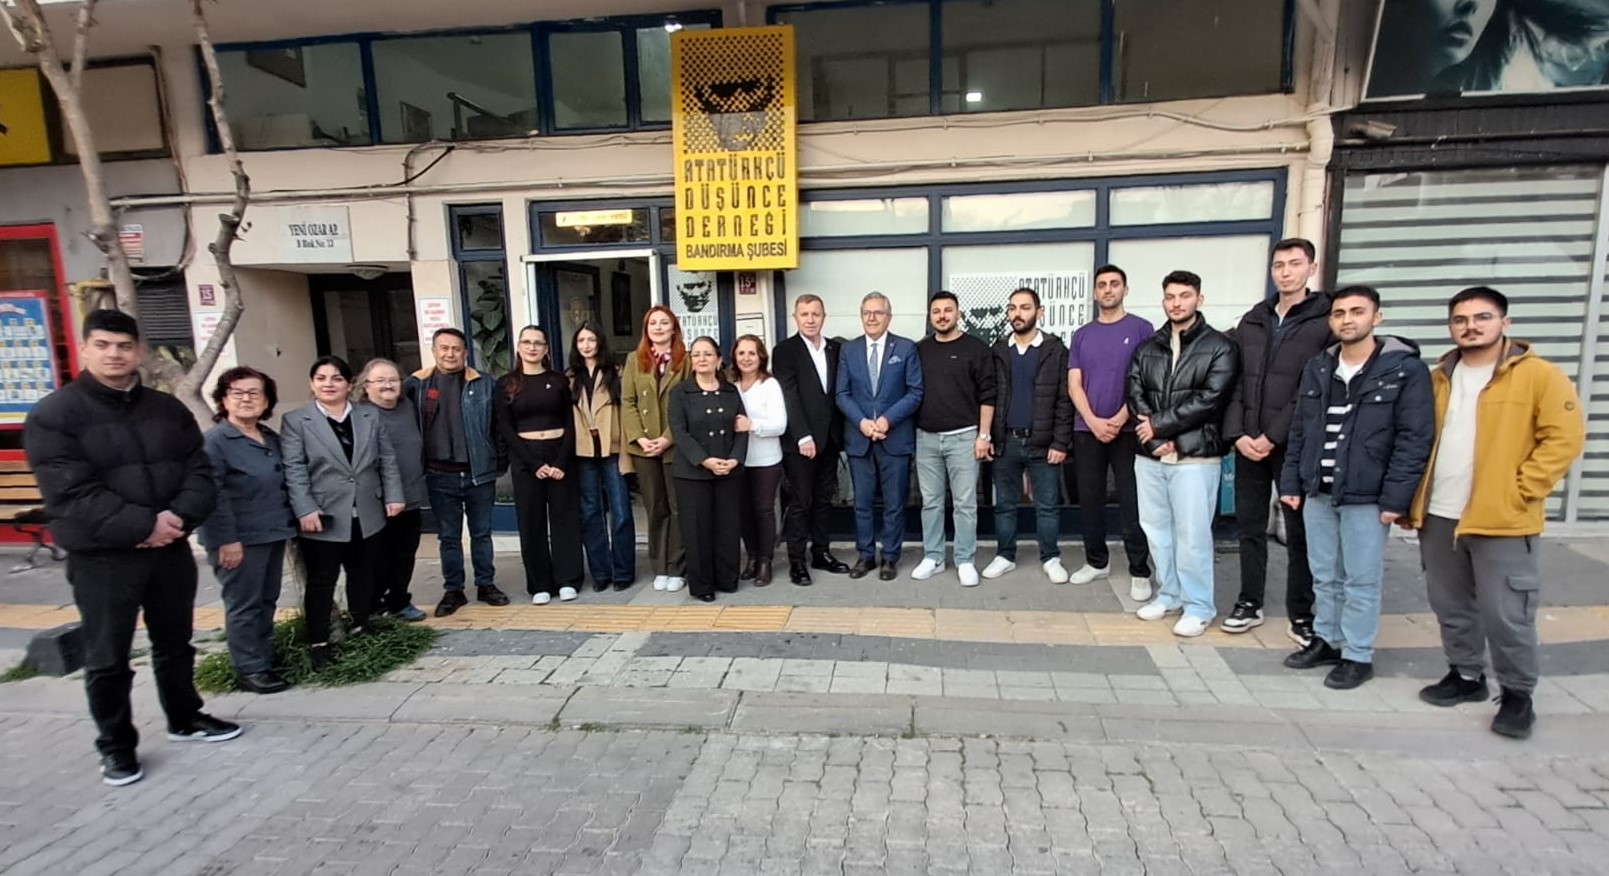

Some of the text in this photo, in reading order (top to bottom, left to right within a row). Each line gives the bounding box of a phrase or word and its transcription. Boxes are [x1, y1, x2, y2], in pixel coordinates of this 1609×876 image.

[684, 152, 785, 181] ATATÜRKÇÜ
[685, 182, 786, 211] DÜŞÜNCE
[686, 209, 786, 238] DERNEĞİ
[686, 238, 787, 261] BANDIRMA ŞUBESİ
